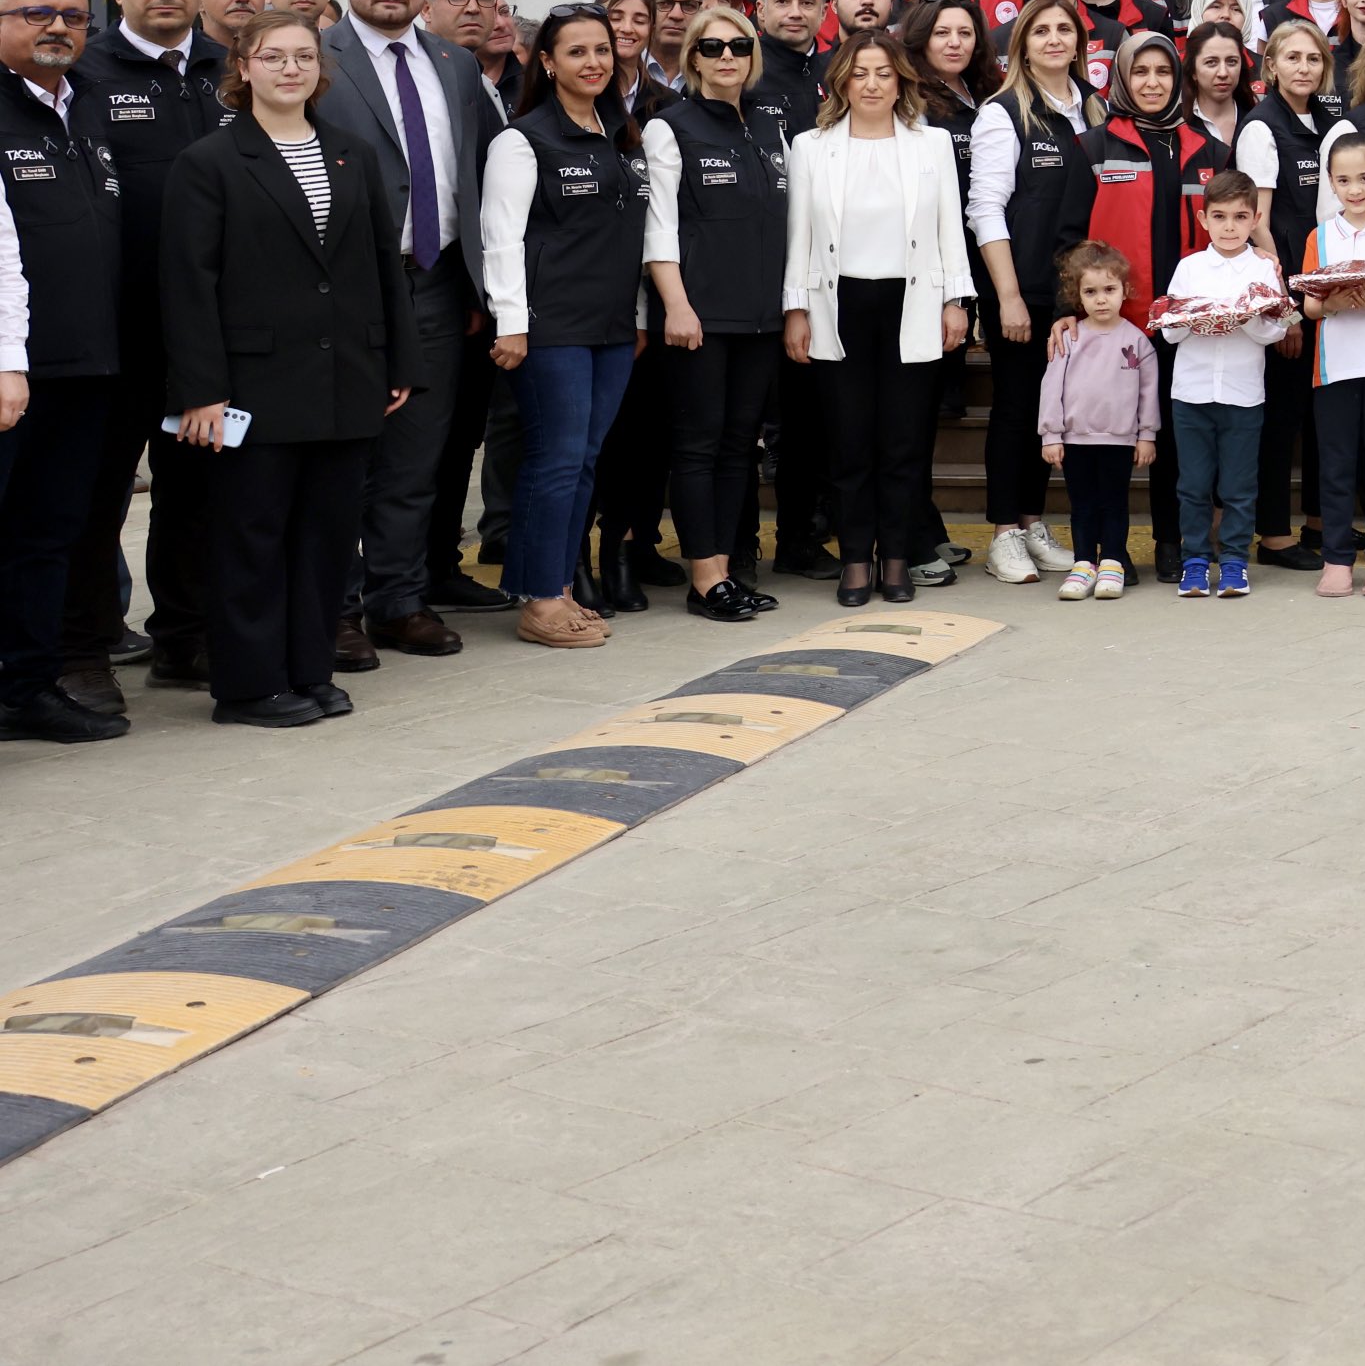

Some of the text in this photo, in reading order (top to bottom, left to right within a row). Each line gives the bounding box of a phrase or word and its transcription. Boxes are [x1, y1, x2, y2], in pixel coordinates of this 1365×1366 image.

[108, 94, 151, 105] TAGEM
[1317, 95, 1342, 104] TAGEM
[1031, 141, 1060, 154] TAGEM
[5, 149, 46, 161] TAGEM
[699, 158, 732, 169] TAGEM
[558, 166, 593, 178] TAGEM
